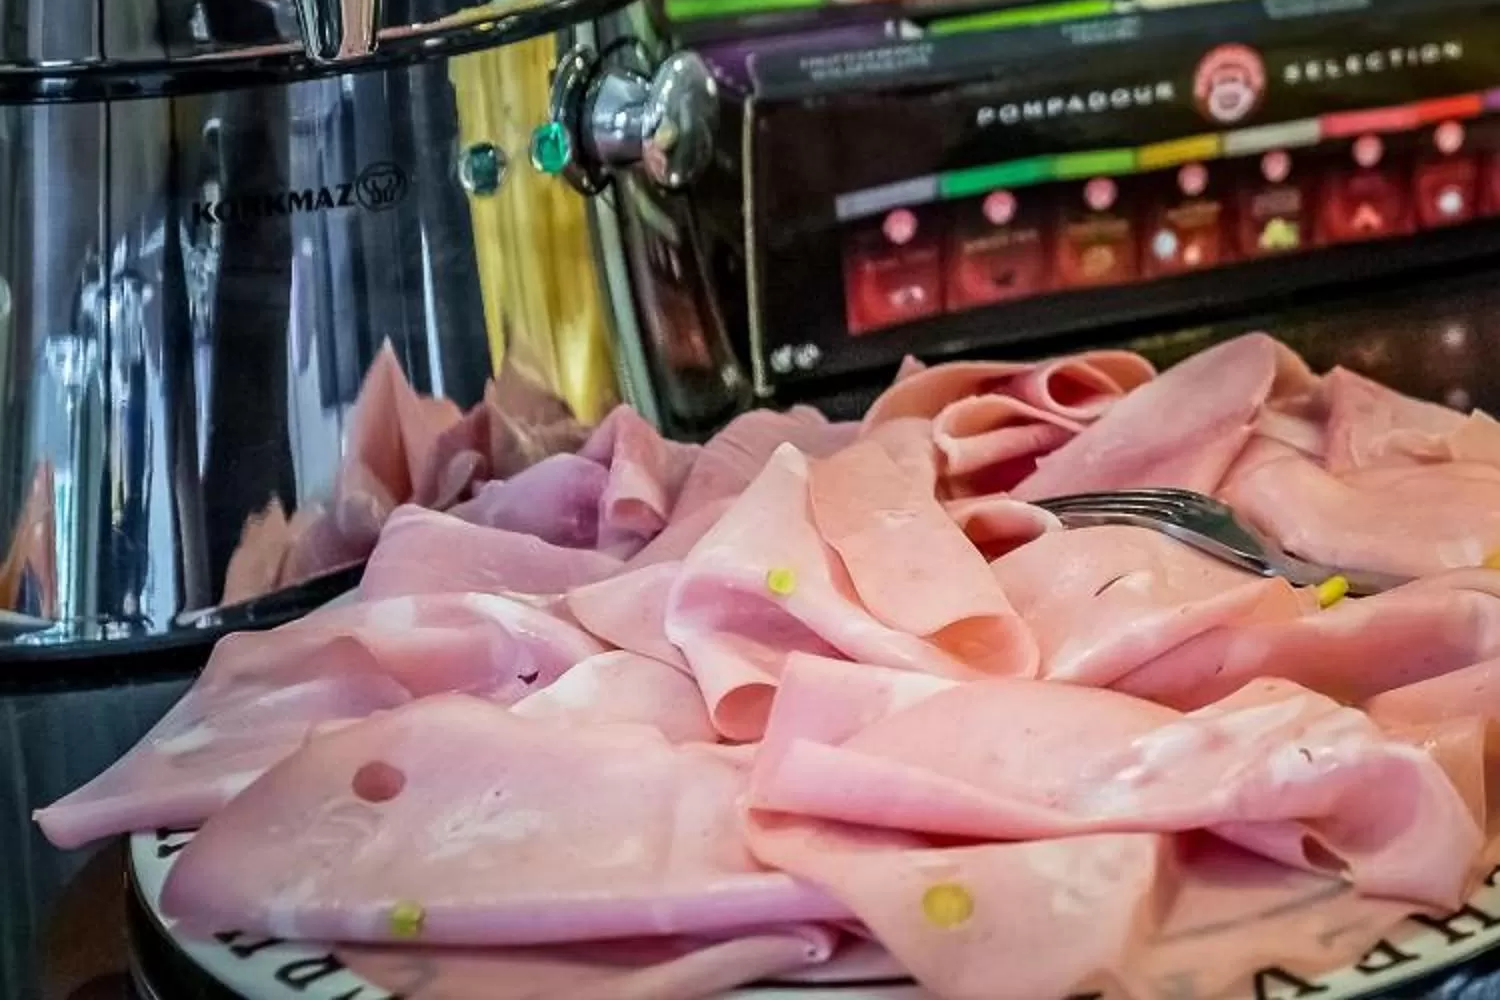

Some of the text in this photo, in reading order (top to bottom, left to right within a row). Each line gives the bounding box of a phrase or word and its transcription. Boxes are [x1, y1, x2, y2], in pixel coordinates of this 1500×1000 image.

[976, 81, 1175, 127] POMPADOUR
[1283, 41, 1463, 85] SELECTION
[192, 183, 355, 226] KORKMAZ
